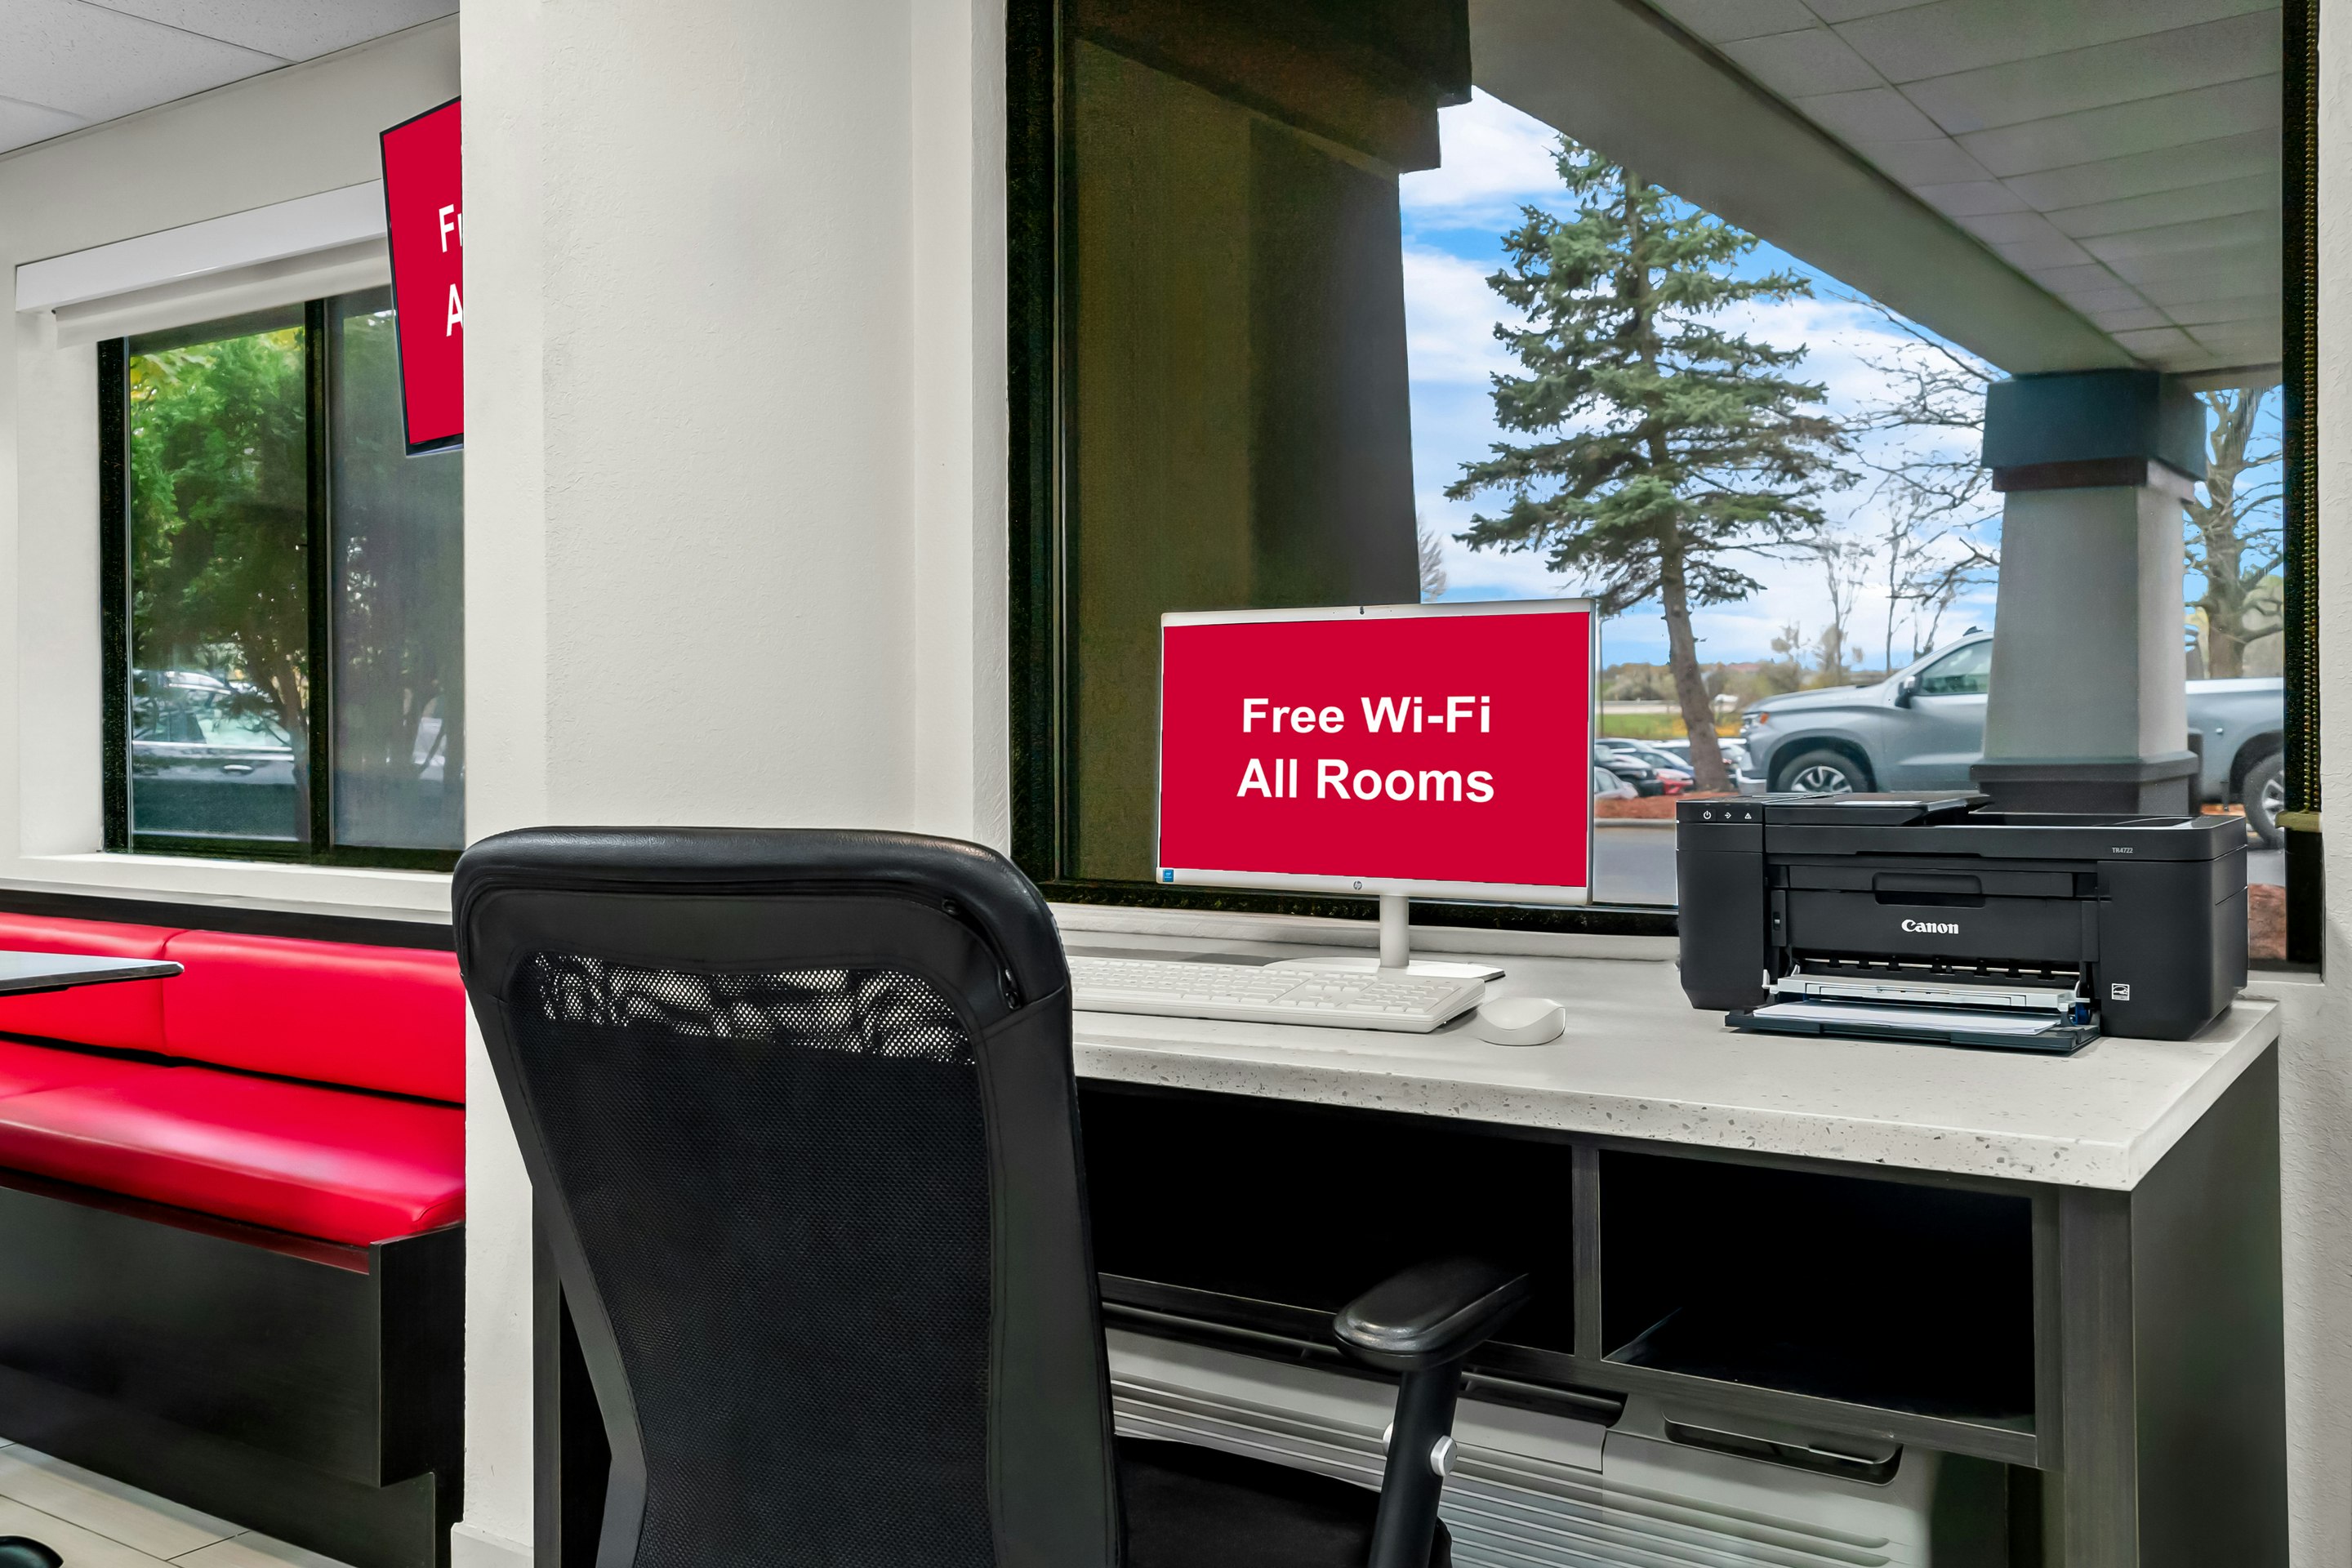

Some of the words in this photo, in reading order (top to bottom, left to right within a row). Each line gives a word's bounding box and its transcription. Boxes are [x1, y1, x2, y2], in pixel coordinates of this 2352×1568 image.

[1242, 697, 1345, 734] Free
[1361, 696, 1490, 733] Wi-Fi
[1236, 758, 1298, 799] All
[1316, 759, 1494, 803] Rooms
[1901, 919, 1959, 934] Canon
